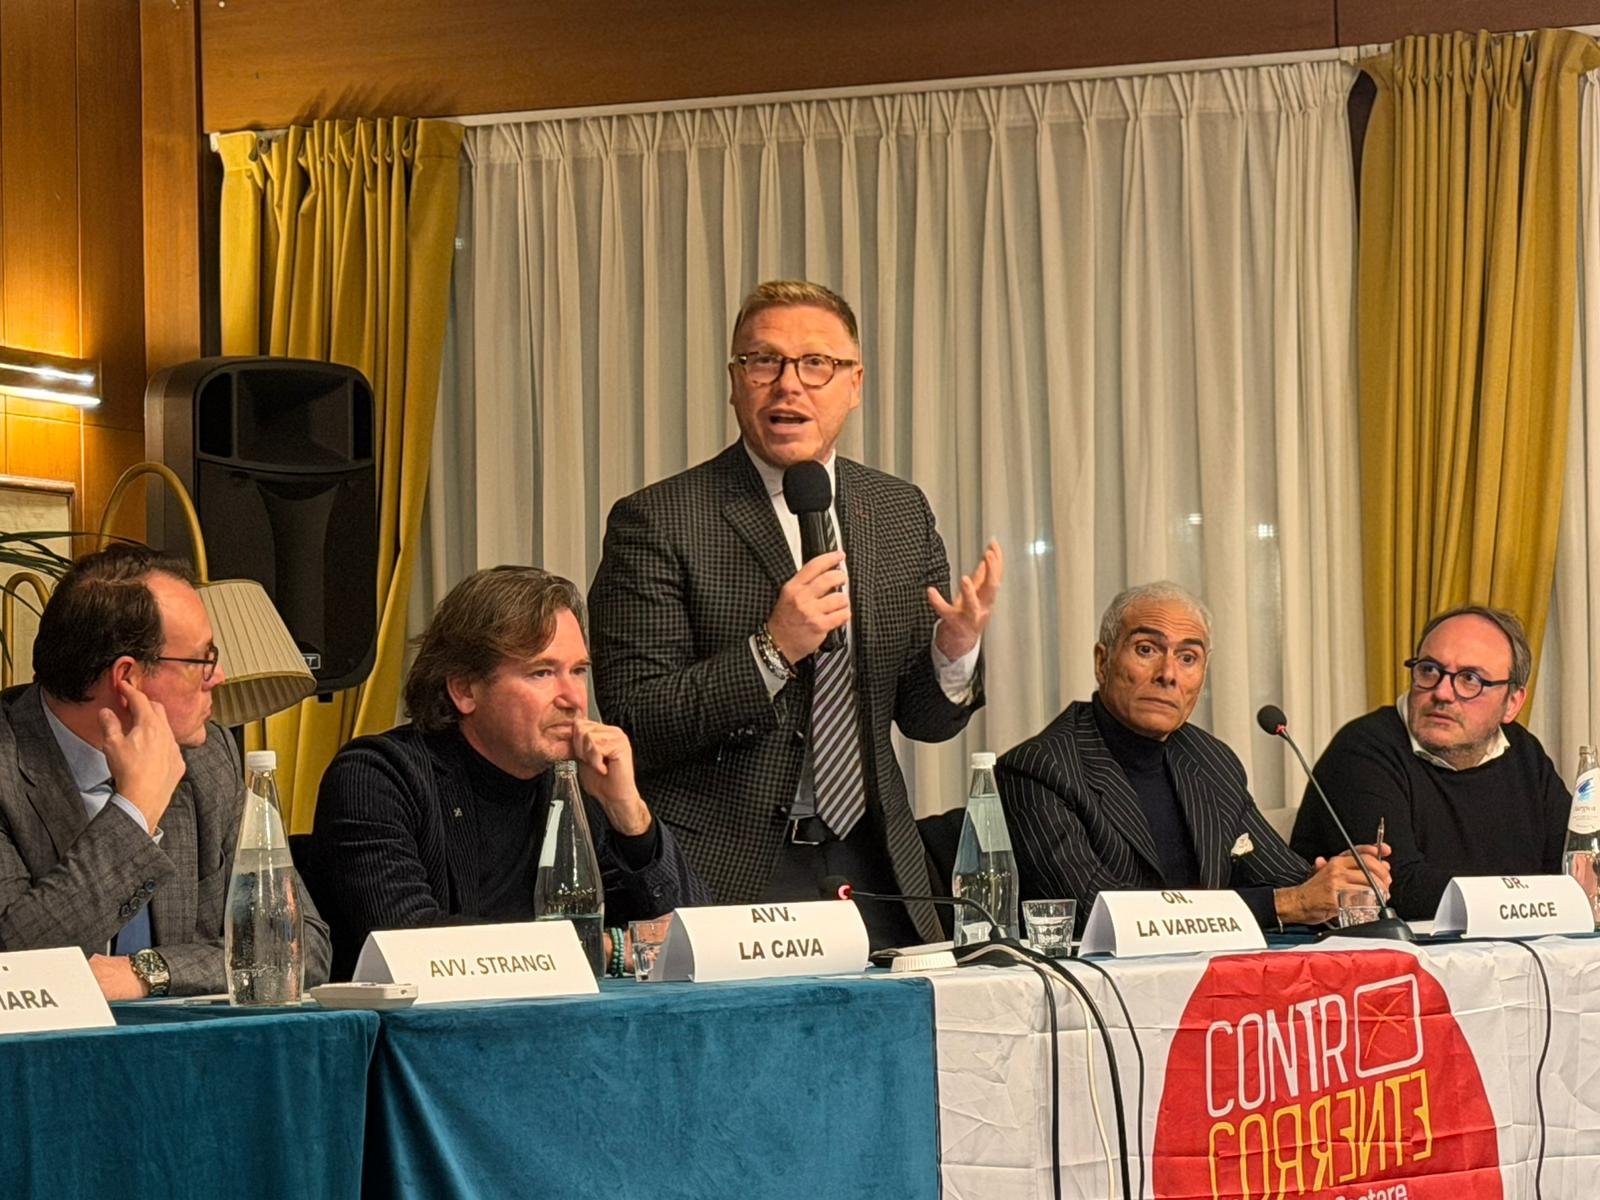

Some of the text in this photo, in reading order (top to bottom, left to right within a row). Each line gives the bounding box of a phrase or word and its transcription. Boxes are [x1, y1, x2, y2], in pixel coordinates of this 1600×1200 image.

[1501, 877, 1530, 889] DR.
[1161, 891, 1193, 904] ON.
[750, 906, 797, 924] AVV.
[1499, 901, 1558, 920] CACACE
[1136, 916, 1242, 938] LA VARDERA
[738, 937, 824, 961] LA CAVA
[430, 953, 557, 978] AVV. STRANGI
